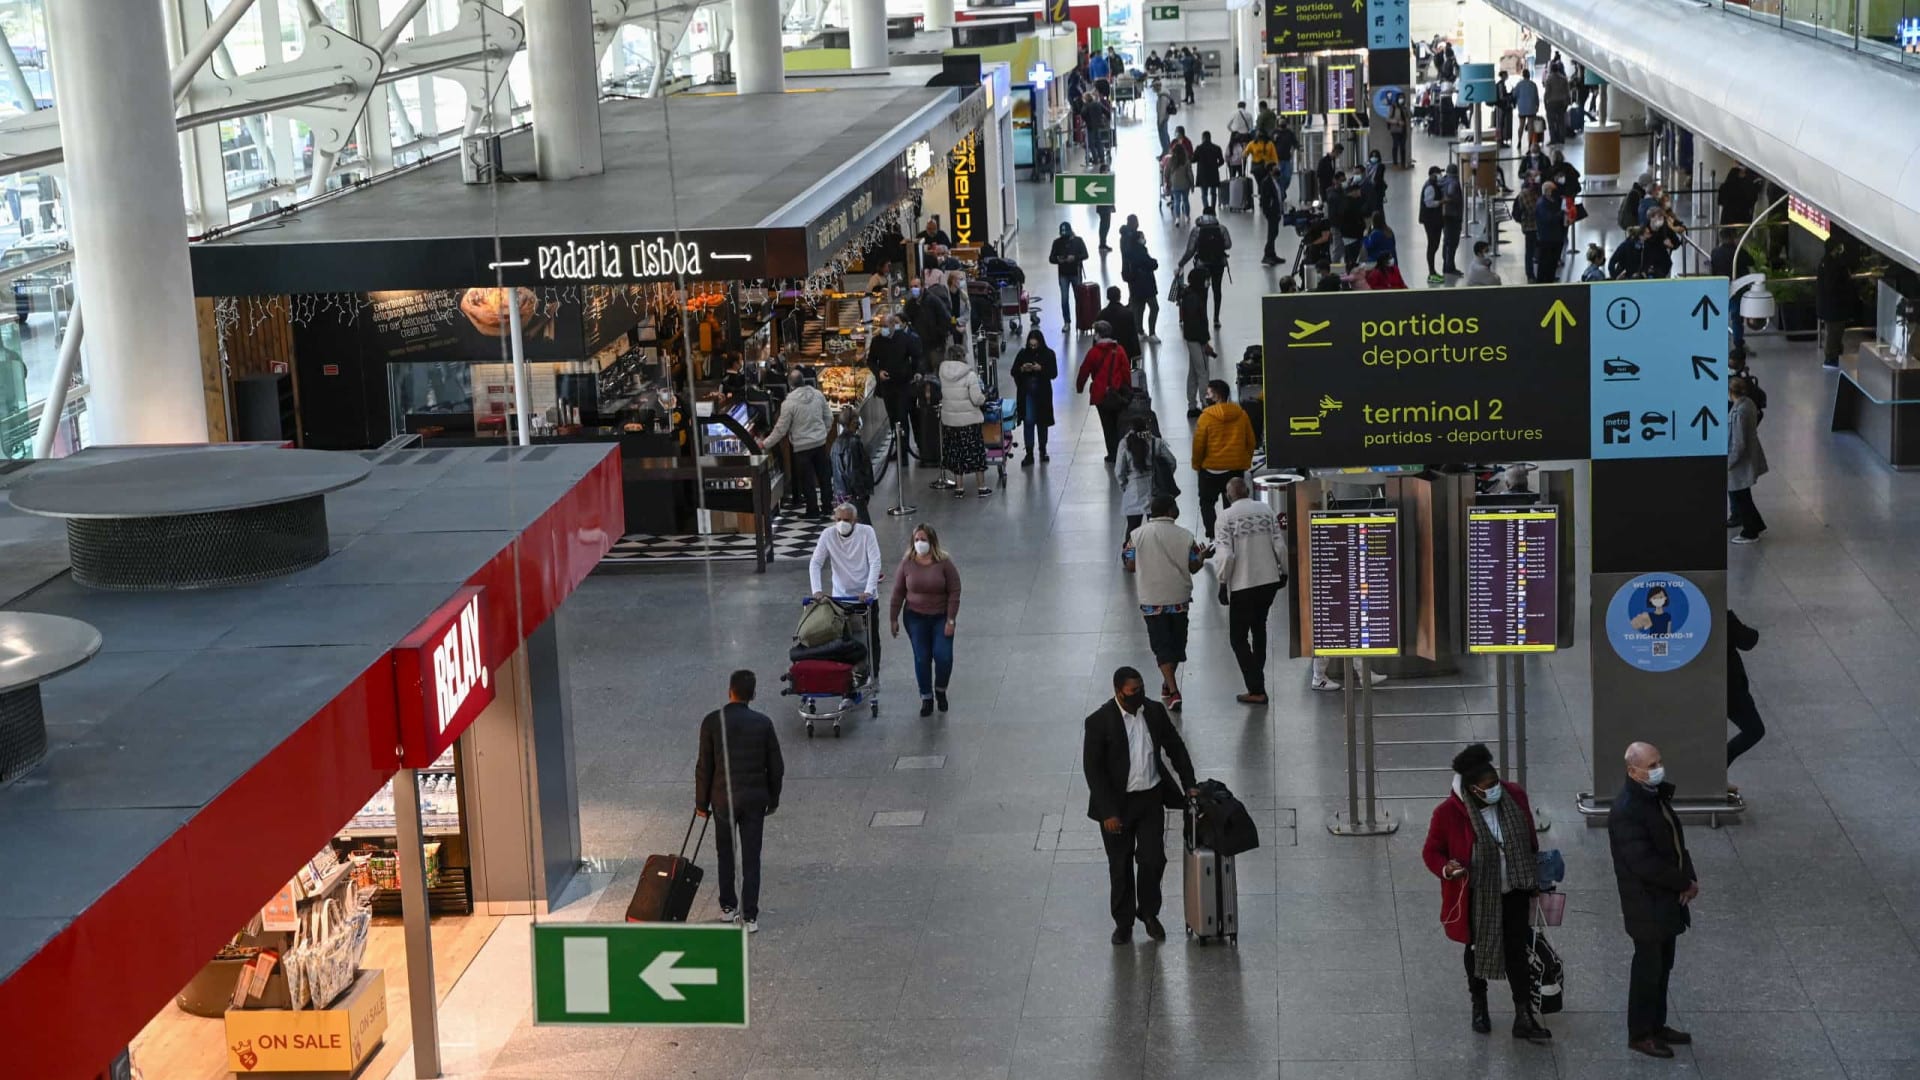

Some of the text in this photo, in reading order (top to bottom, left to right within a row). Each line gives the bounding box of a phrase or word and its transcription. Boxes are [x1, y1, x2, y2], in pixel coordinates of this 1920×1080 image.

[1296, 2, 1334, 12] partidas
[1297, 11, 1343, 22] departures
[1297, 30, 1342, 40] terminal 2
[1464, 84, 1474, 101] 2
[1361, 313, 1479, 343] partidas
[1362, 344, 1508, 370] departures
[1362, 399, 1503, 424] terminal 2
[1605, 418, 1629, 426] metro
[1364, 430, 1432, 448] partidas
[1447, 428, 1543, 445] departures
[359, 995, 385, 1034] ON SALE
[258, 1034, 341, 1049] ON SALE
